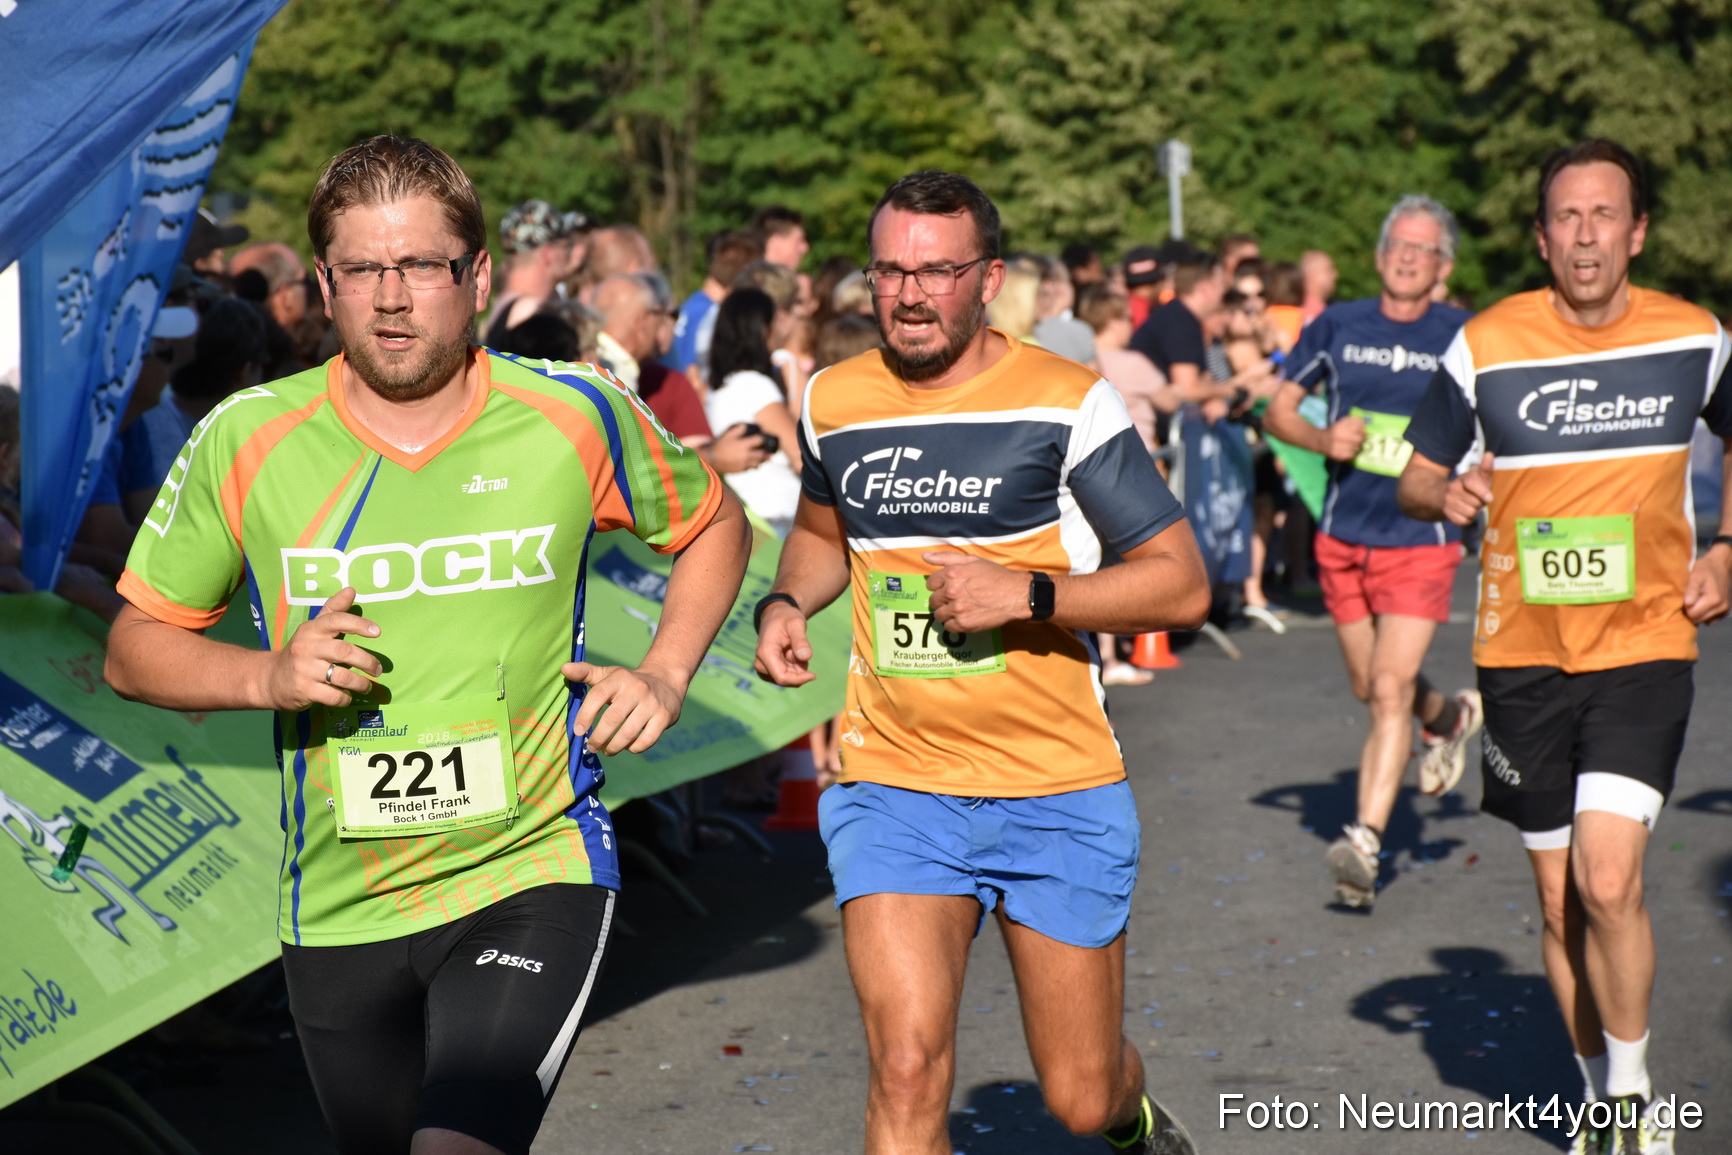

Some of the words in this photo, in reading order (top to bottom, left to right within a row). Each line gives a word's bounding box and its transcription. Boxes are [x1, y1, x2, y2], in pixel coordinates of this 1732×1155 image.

[542, 358, 683, 457] BO
[1547, 394, 1674, 424] Fischer
[1559, 416, 1666, 436] AUTOMOBILE
[864, 469, 1003, 500] Fischer
[877, 502, 989, 515] AUTOMOBILE
[280, 523, 557, 607] BOCK
[1542, 549, 1607, 578] 605
[893, 650, 948, 662] Krauberger
[951, 650, 973, 661] Igor
[914, 661, 953, 669] Automobile
[955, 659, 979, 667] GmbH
[350, 724, 408, 737] firmenlauf
[417, 731, 450, 744] 2018
[367, 746, 466, 799] 221
[379, 800, 427, 814] Pfindel
[431, 794, 471, 809] Frank
[393, 815, 417, 823] Bock
[419, 813, 425, 821] 1
[428, 810, 457, 821] GmbH
[164, 841, 240, 912] neumarkt
[497, 953, 543, 973] asics
